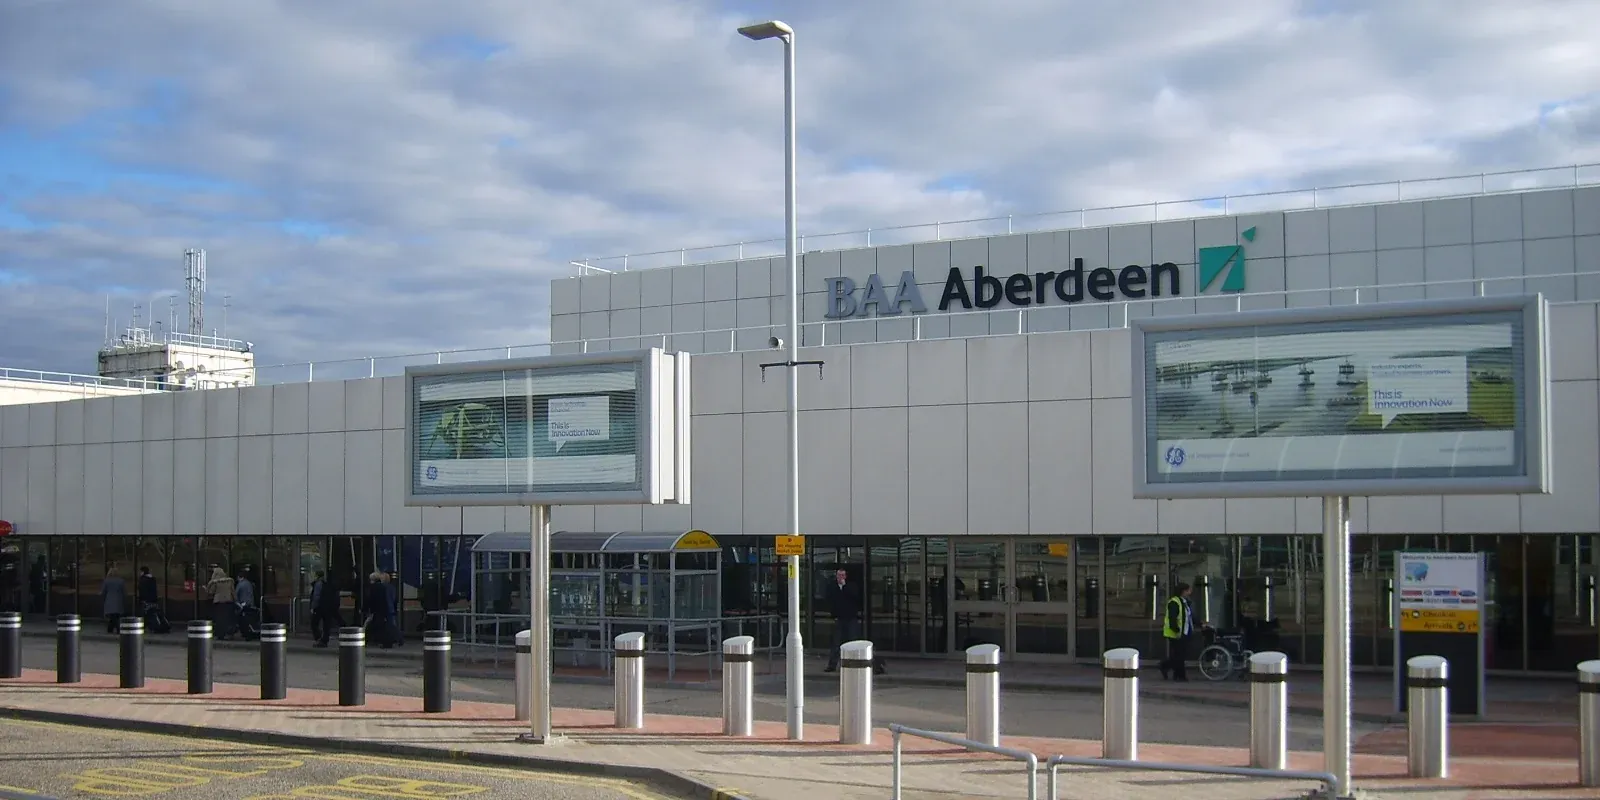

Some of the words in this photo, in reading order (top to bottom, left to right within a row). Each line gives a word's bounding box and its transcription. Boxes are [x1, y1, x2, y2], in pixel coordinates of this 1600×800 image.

[824, 271, 928, 319] BAA
[938, 257, 1181, 310] Aberdeen
[1373, 389, 1393, 399] This
[1394, 389, 1403, 399] is
[1374, 399, 1428, 409] Innovation
[1429, 397, 1453, 407] Now
[551, 422, 564, 430] This
[551, 429, 585, 437] Innovation
[59, 753, 304, 796] STOP
[240, 774, 490, 800] BU
